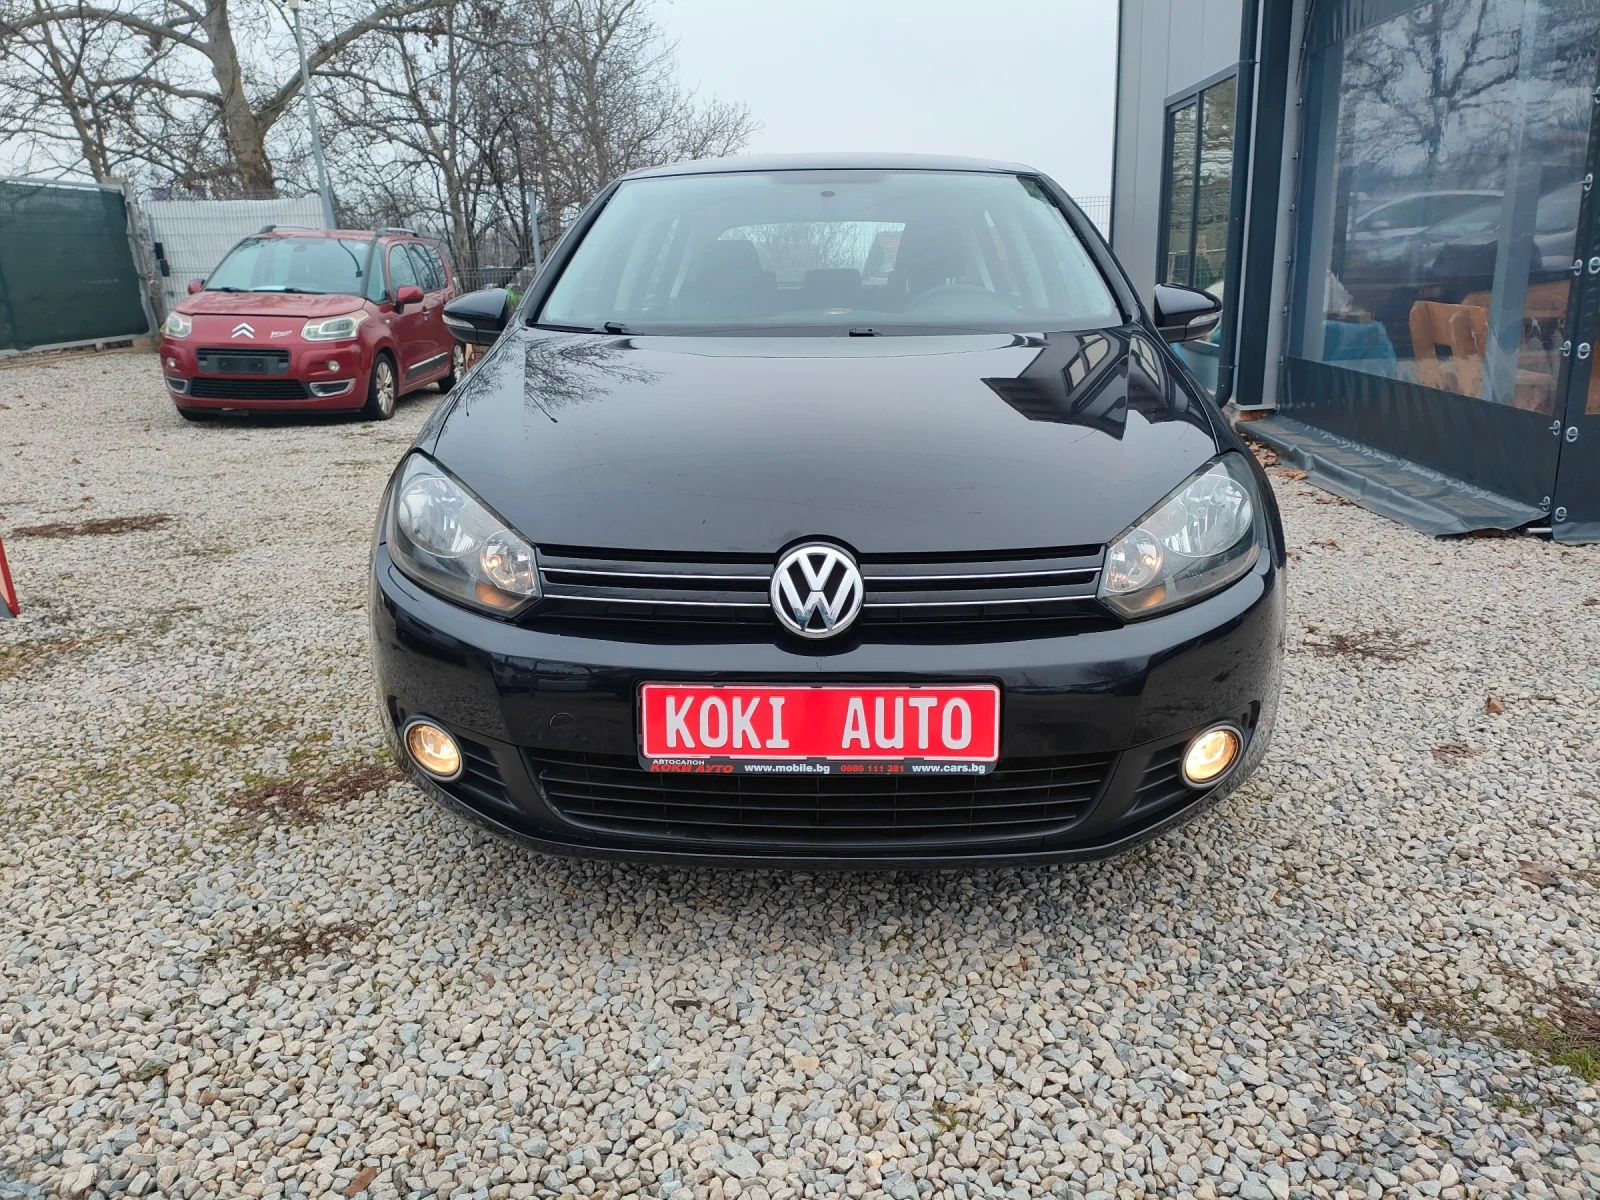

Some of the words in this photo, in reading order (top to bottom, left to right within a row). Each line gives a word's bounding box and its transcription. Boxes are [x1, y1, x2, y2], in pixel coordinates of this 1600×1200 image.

[773, 546, 861, 635] VW
[665, 695, 790, 749] KOKI
[841, 696, 972, 750] AUTO
[650, 764, 692, 772] КОКИ
[695, 765, 734, 773] АУТО
[744, 763, 830, 774] www.mobile.bg
[840, 764, 864, 772] 0886
[867, 764, 884, 772] 111
[887, 764, 904, 772] 381
[912, 763, 986, 774] www.cars.bg
